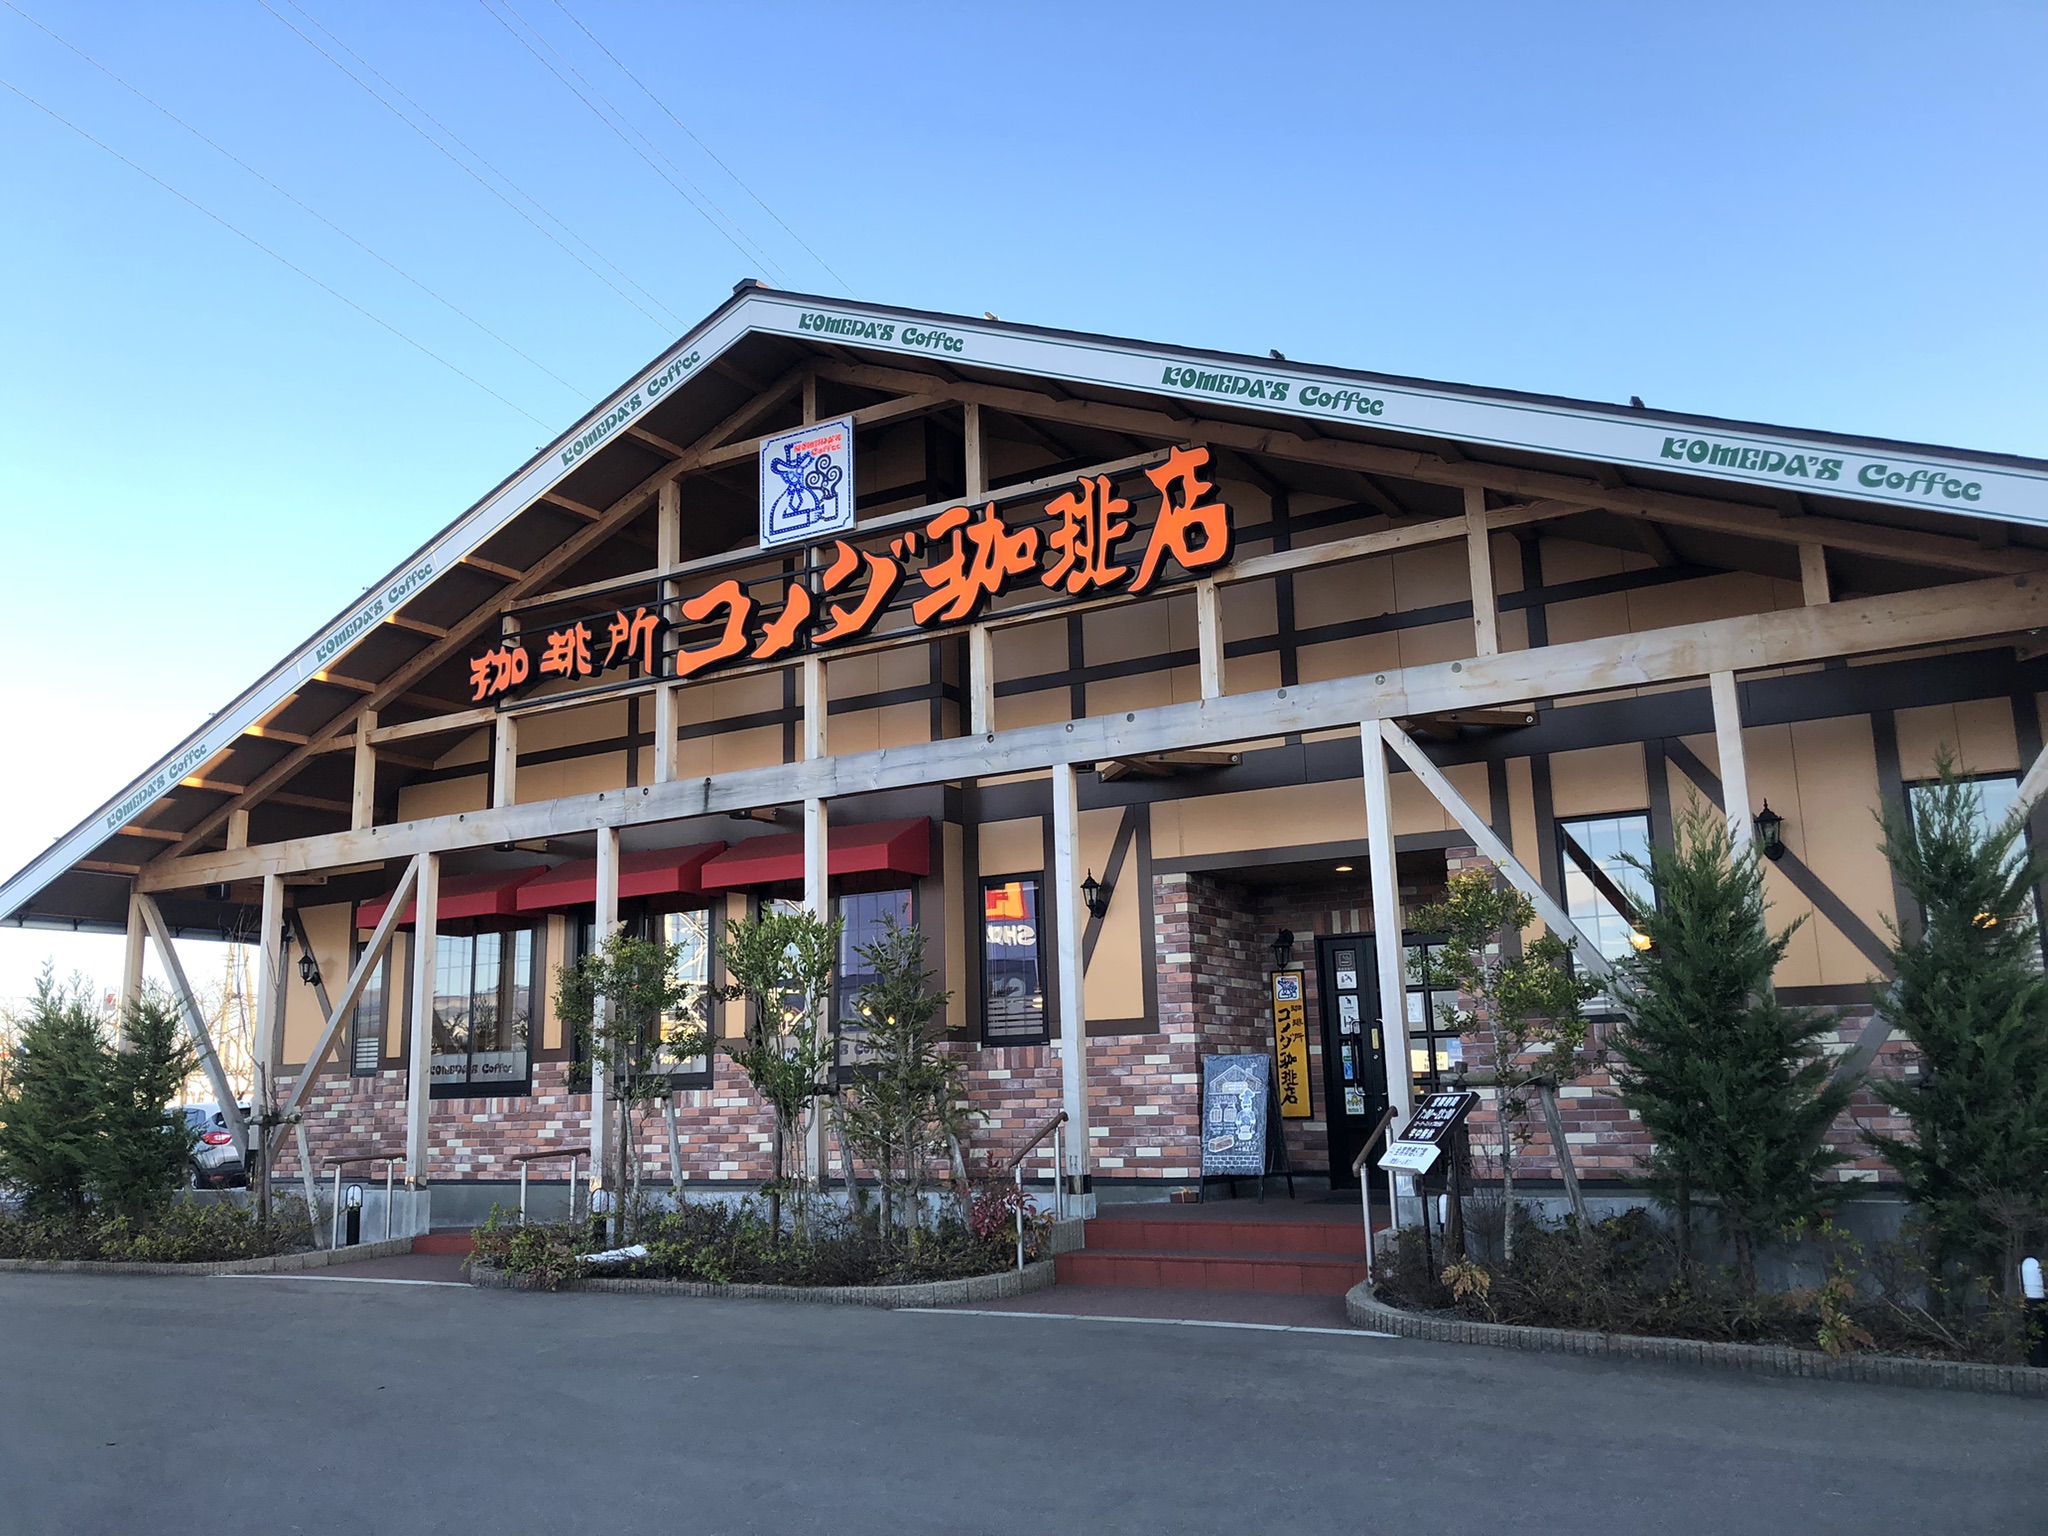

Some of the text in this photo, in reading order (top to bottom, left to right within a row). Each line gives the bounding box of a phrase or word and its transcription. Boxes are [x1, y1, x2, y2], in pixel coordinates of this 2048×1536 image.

[799, 313, 964, 352] KOMEDA'S Coffee
[560, 351, 701, 467] KOMEDA'S Coffee
[1162, 366, 1384, 416] KOMEDA'S Coffee
[1660, 436, 1982, 501] KOMEDA'S Coffee
[315, 563, 433, 662] KOMEDA'S Coffee
[106, 744, 207, 829] KOMEDA'S Coffee
[430, 1064, 479, 1075] OMEDAS
[1278, 1007, 1299, 1106] コメダ珈琲店
